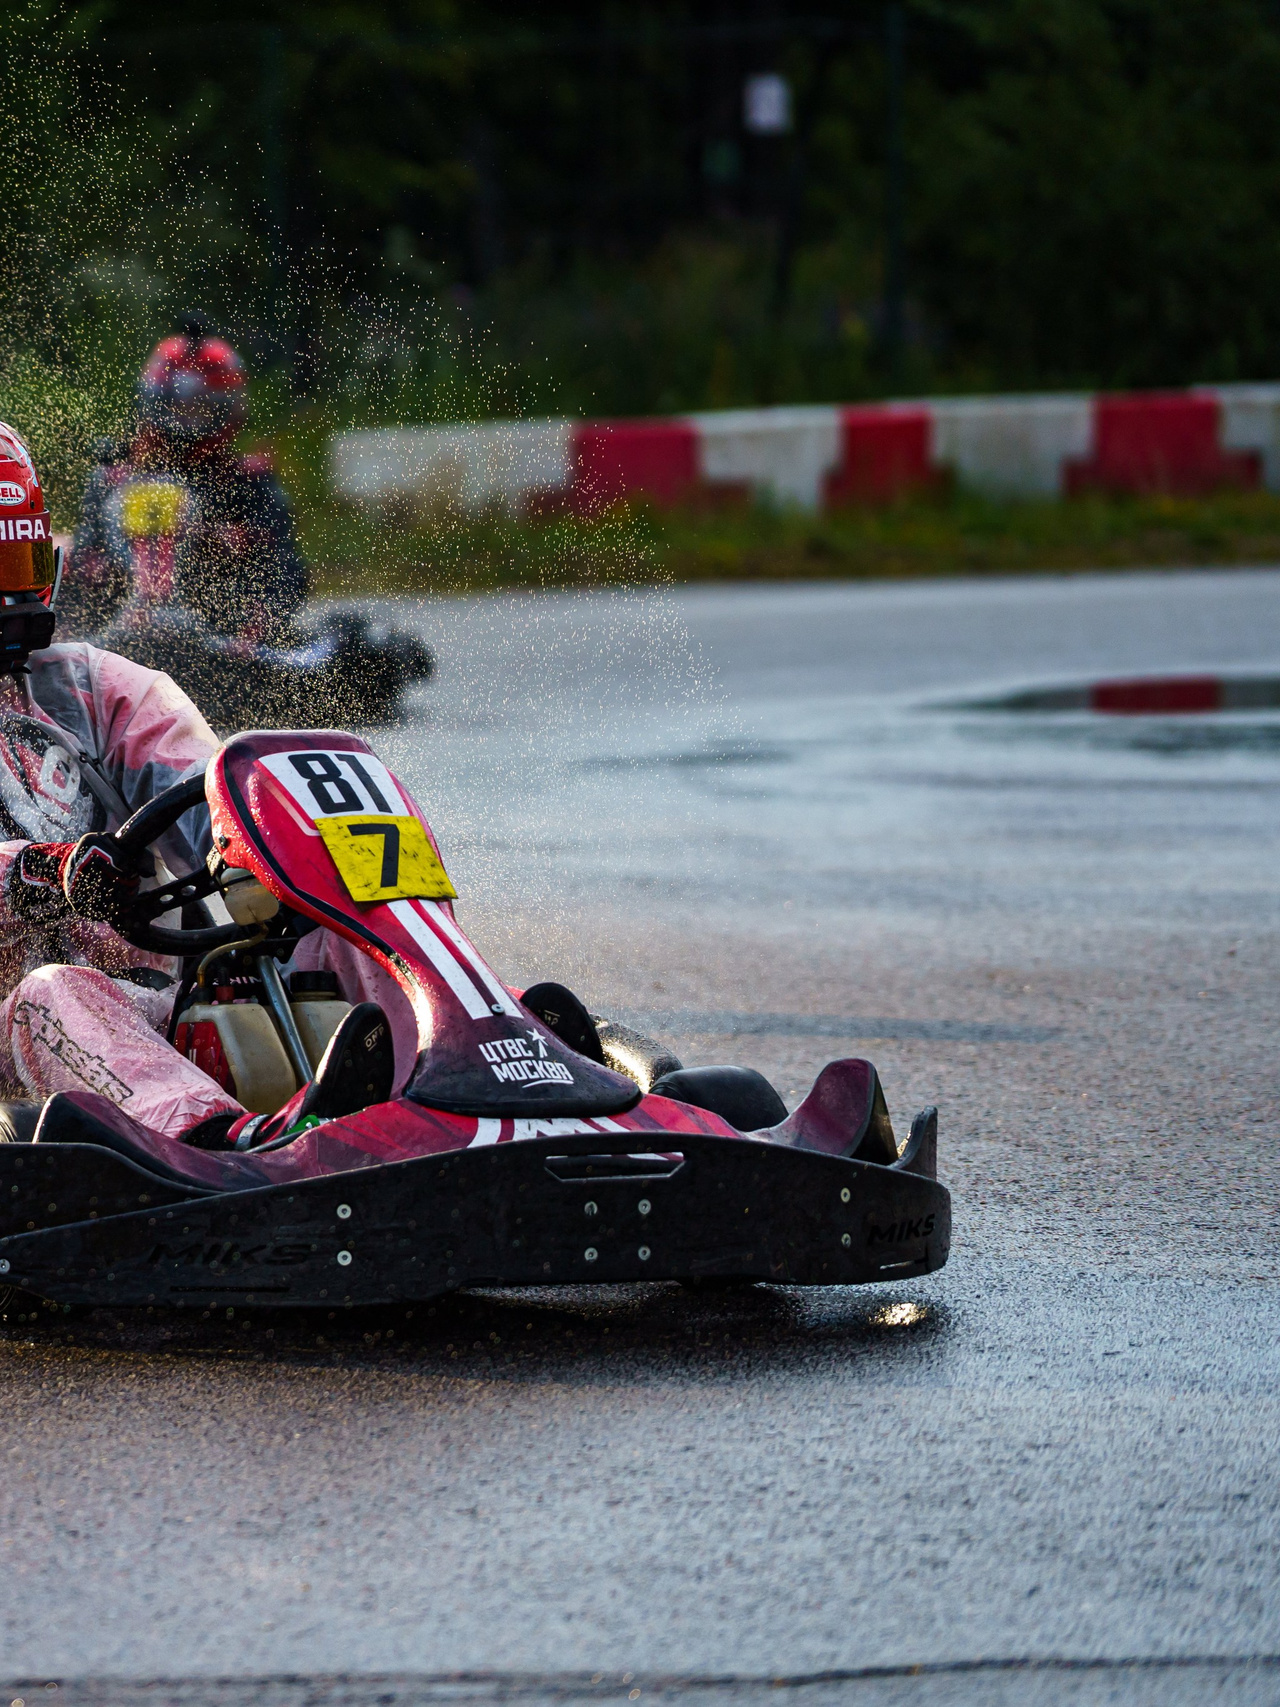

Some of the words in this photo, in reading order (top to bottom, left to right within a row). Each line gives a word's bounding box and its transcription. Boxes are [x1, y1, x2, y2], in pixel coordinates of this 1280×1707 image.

[288, 753, 394, 815] 81
[347, 823, 401, 888] 7
[478, 1038, 535, 1064] ЦТВС
[491, 1060, 574, 1083] МОСКВА
[867, 1213, 936, 1246] MIKS
[146, 1243, 313, 1266] MIKS
